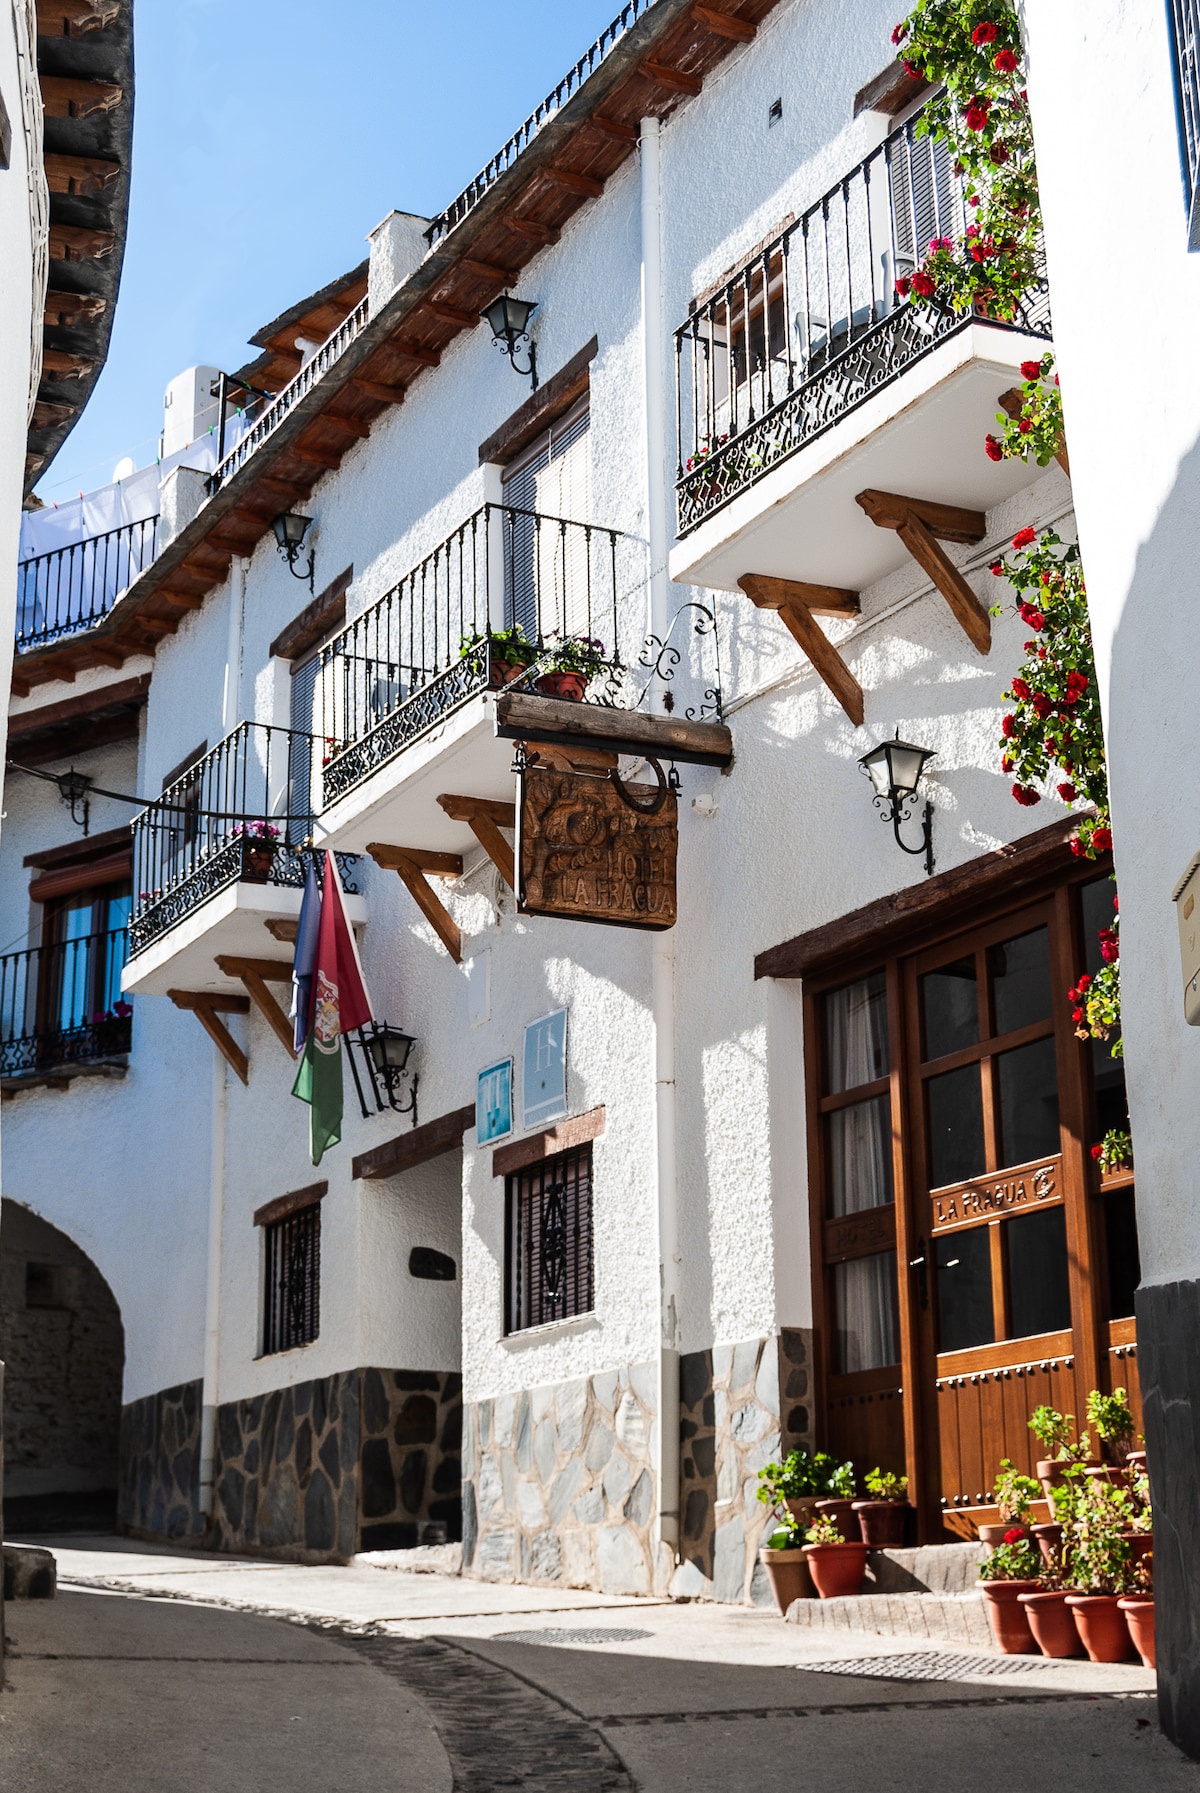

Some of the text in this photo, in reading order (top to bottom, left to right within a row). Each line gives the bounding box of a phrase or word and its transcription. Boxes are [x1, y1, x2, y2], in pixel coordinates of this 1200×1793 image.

[607, 850, 674, 885] HOTEL
[562, 874, 674, 915] LA FRAGUA
[936, 1180, 1028, 1221] LA FRAGUA
